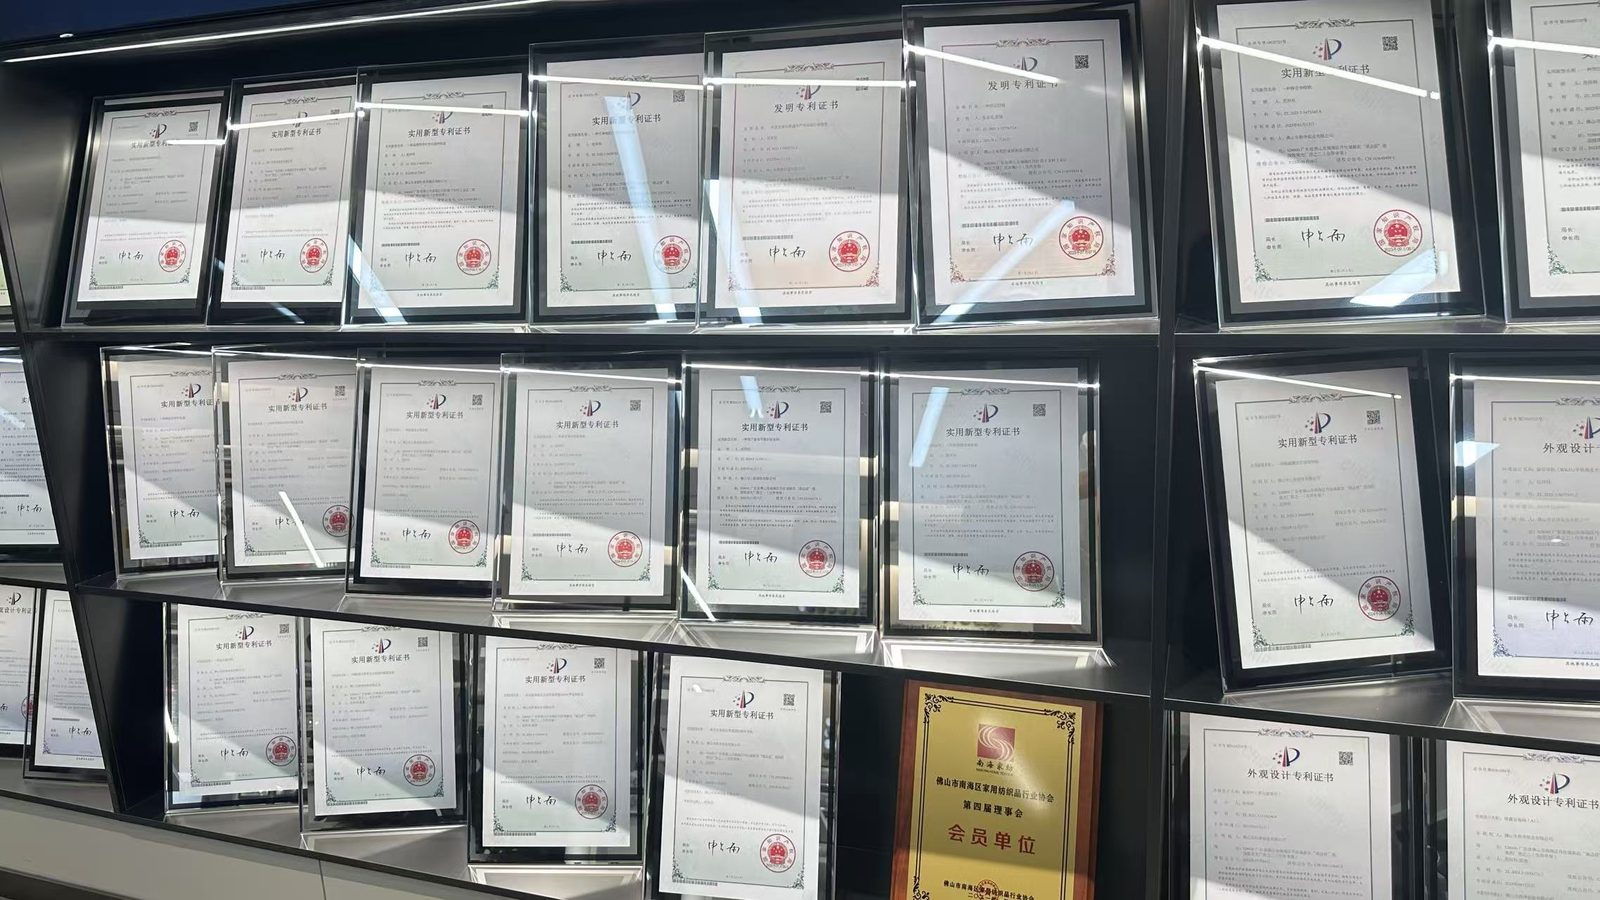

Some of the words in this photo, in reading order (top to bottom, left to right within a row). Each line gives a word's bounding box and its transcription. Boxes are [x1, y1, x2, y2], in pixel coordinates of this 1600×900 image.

[774, 99, 840, 114] 发明专利证书
[271, 127, 322, 139] 实用新型专利证书
[408, 126, 472, 138] 实用新型专利证书
[268, 402, 328, 413] 实用新型专利证书
[406, 411, 464, 420] 实用新型专利证书
[556, 420, 619, 431] 实用新型专利证书
[742, 421, 808, 432] 实用新型专利证书
[945, 426, 1020, 438] 实用新型专利证书
[1278, 433, 1358, 450] 实用新型专利证书
[216, 639, 272, 651] 实用新型专利证书
[352, 653, 410, 665] 实用新型专利证书
[525, 675, 586, 684] 实用新型专利证书
[710, 709, 774, 720] 实用新型专利证书
[1247, 768, 1334, 783] 外观设计专利证书
[936, 776, 1055, 803] 佛山市南海区家用纺织品行业协会
[1507, 793, 1600, 810] 外观设计专利证书
[962, 799, 1024, 819] 第四届理事会
[948, 823, 1036, 855] 会员单位
